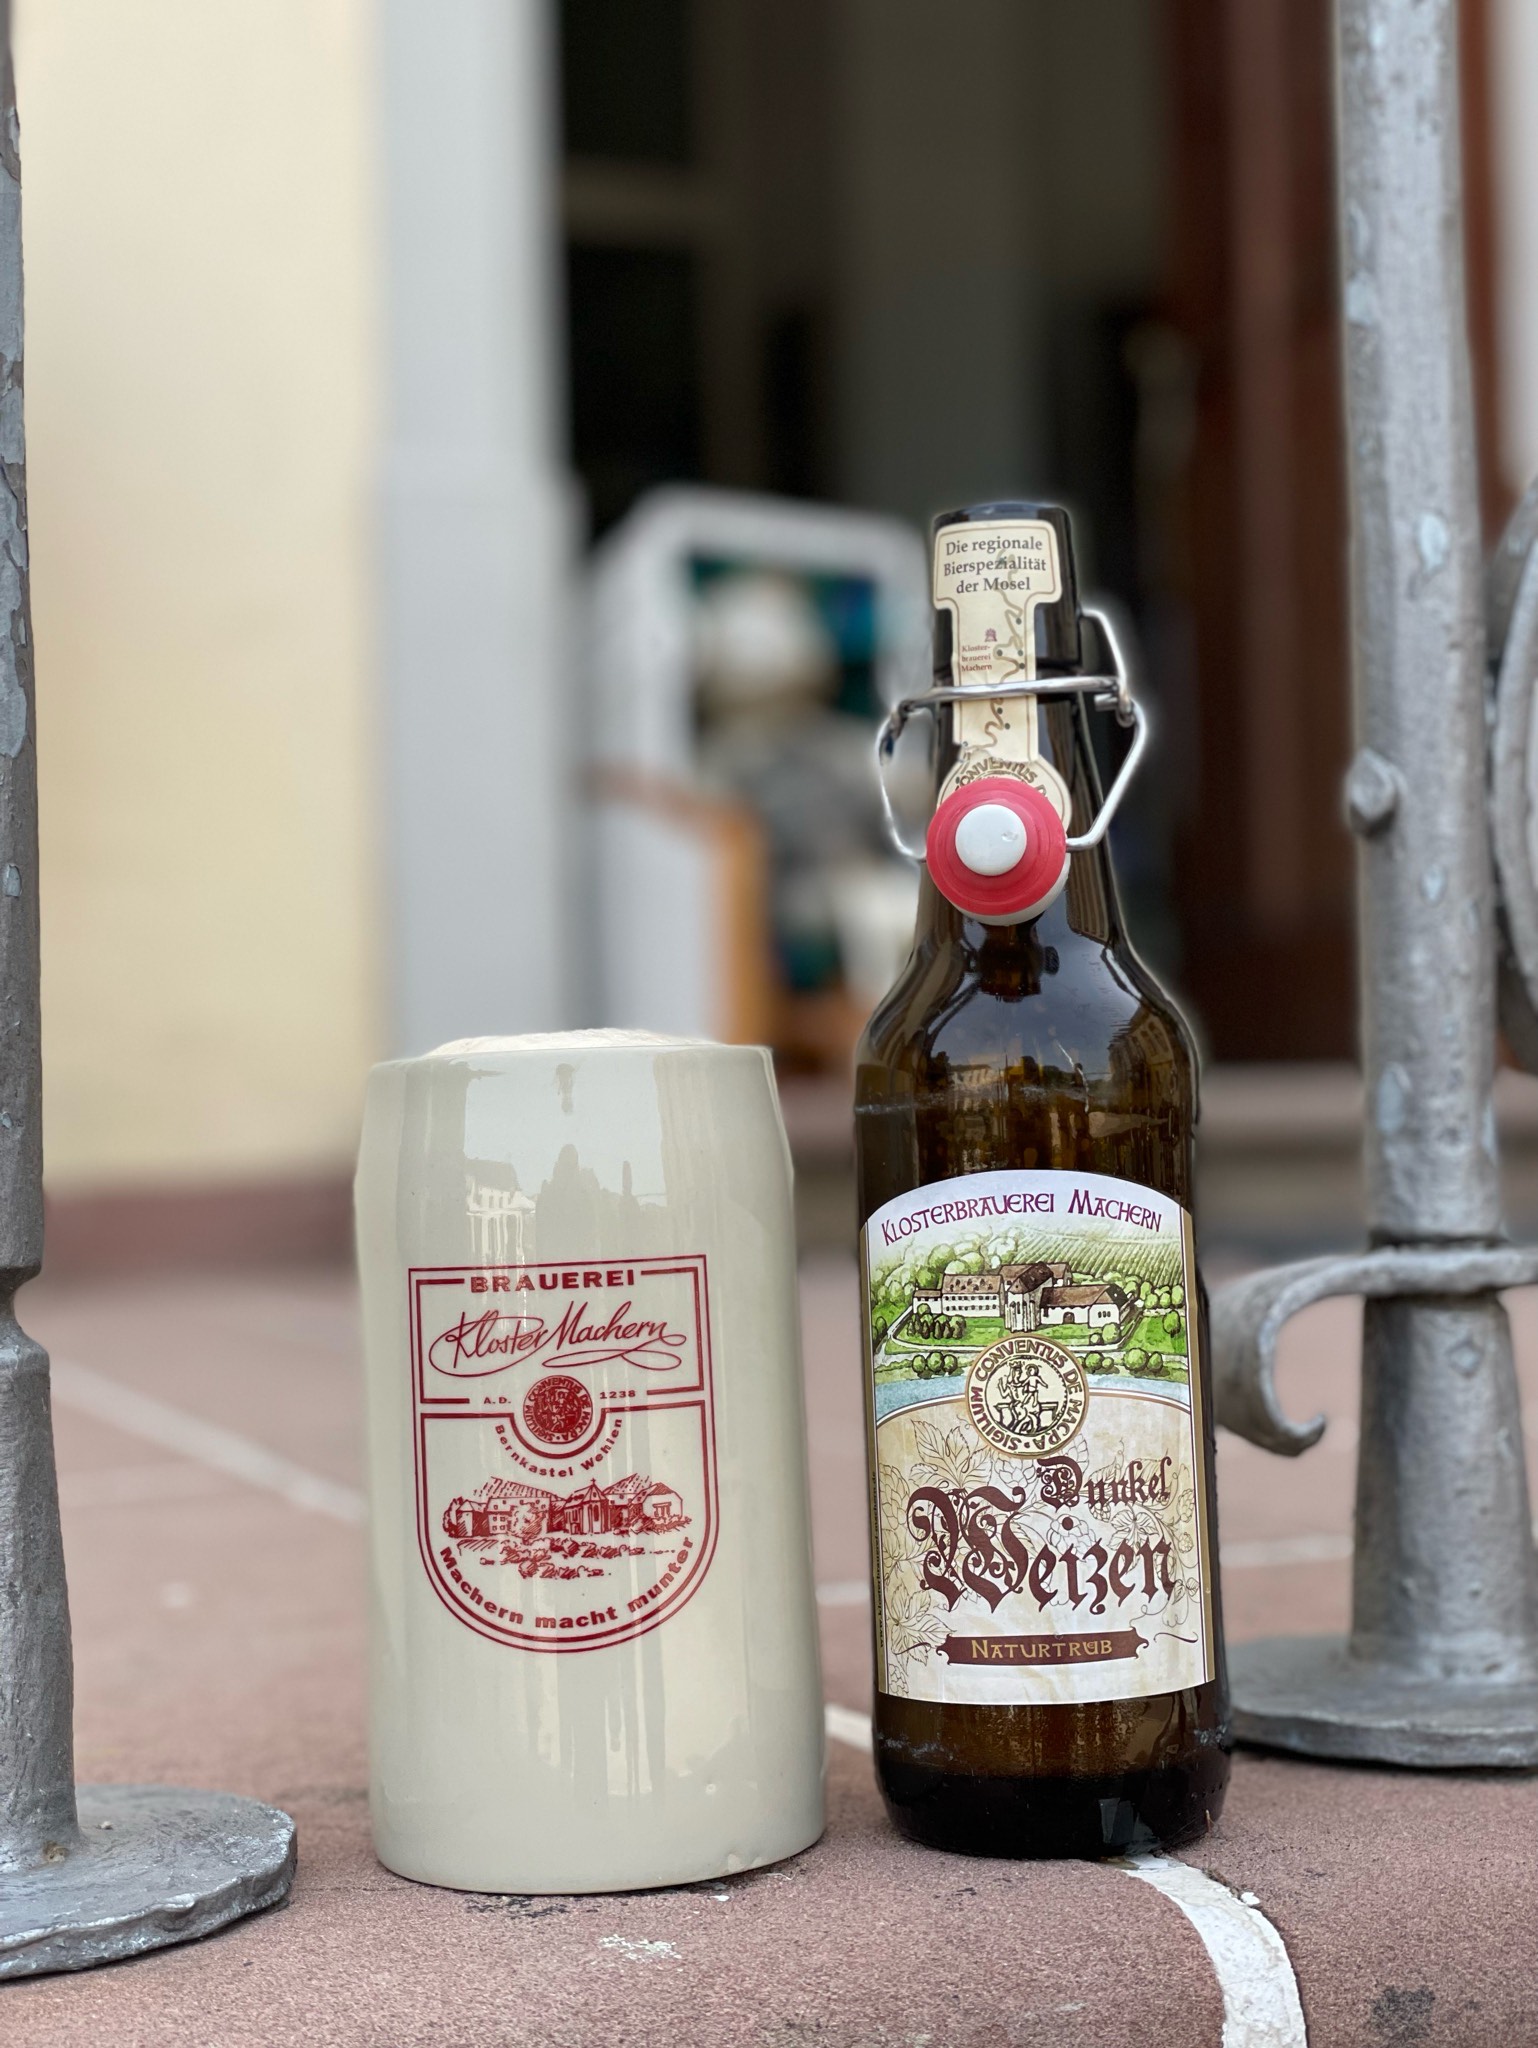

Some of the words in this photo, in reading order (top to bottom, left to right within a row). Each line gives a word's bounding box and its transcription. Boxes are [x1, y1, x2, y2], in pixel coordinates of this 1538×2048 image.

[946, 540, 970, 556] Die
[971, 536, 1043, 555] regionale
[943, 557, 1047, 577] Bierspezialität
[956, 579, 979, 594] der
[983, 576, 1031, 592] Mosel
[961, 654, 991, 662] brauerei
[962, 645, 991, 653] Kloster-
[961, 664, 992, 672] Machern
[955, 757, 1037, 791] ONVENTUS
[881, 1193, 1055, 1247] KLOSTERBRAUEREI
[1067, 1188, 1163, 1233] MACHERN
[470, 1269, 634, 1293] BRAUEREI
[975, 1339, 1069, 1382] CONVENTUS
[1062, 1368, 1083, 1395] DE
[483, 1396, 512, 1405] A.D.
[599, 1389, 637, 1400] 1238
[579, 1394, 592, 1409] DE
[971, 1386, 1022, 1451] SIGILLUM
[495, 1423, 574, 1478] Bernkastel
[580, 1417, 623, 1472] Wehlen
[1036, 1455, 1172, 1510] Dunkel
[906, 1484, 1178, 1615] Weizen
[439, 1546, 524, 1625] Machern
[534, 1605, 618, 1629] macht
[627, 1536, 695, 1613] munter
